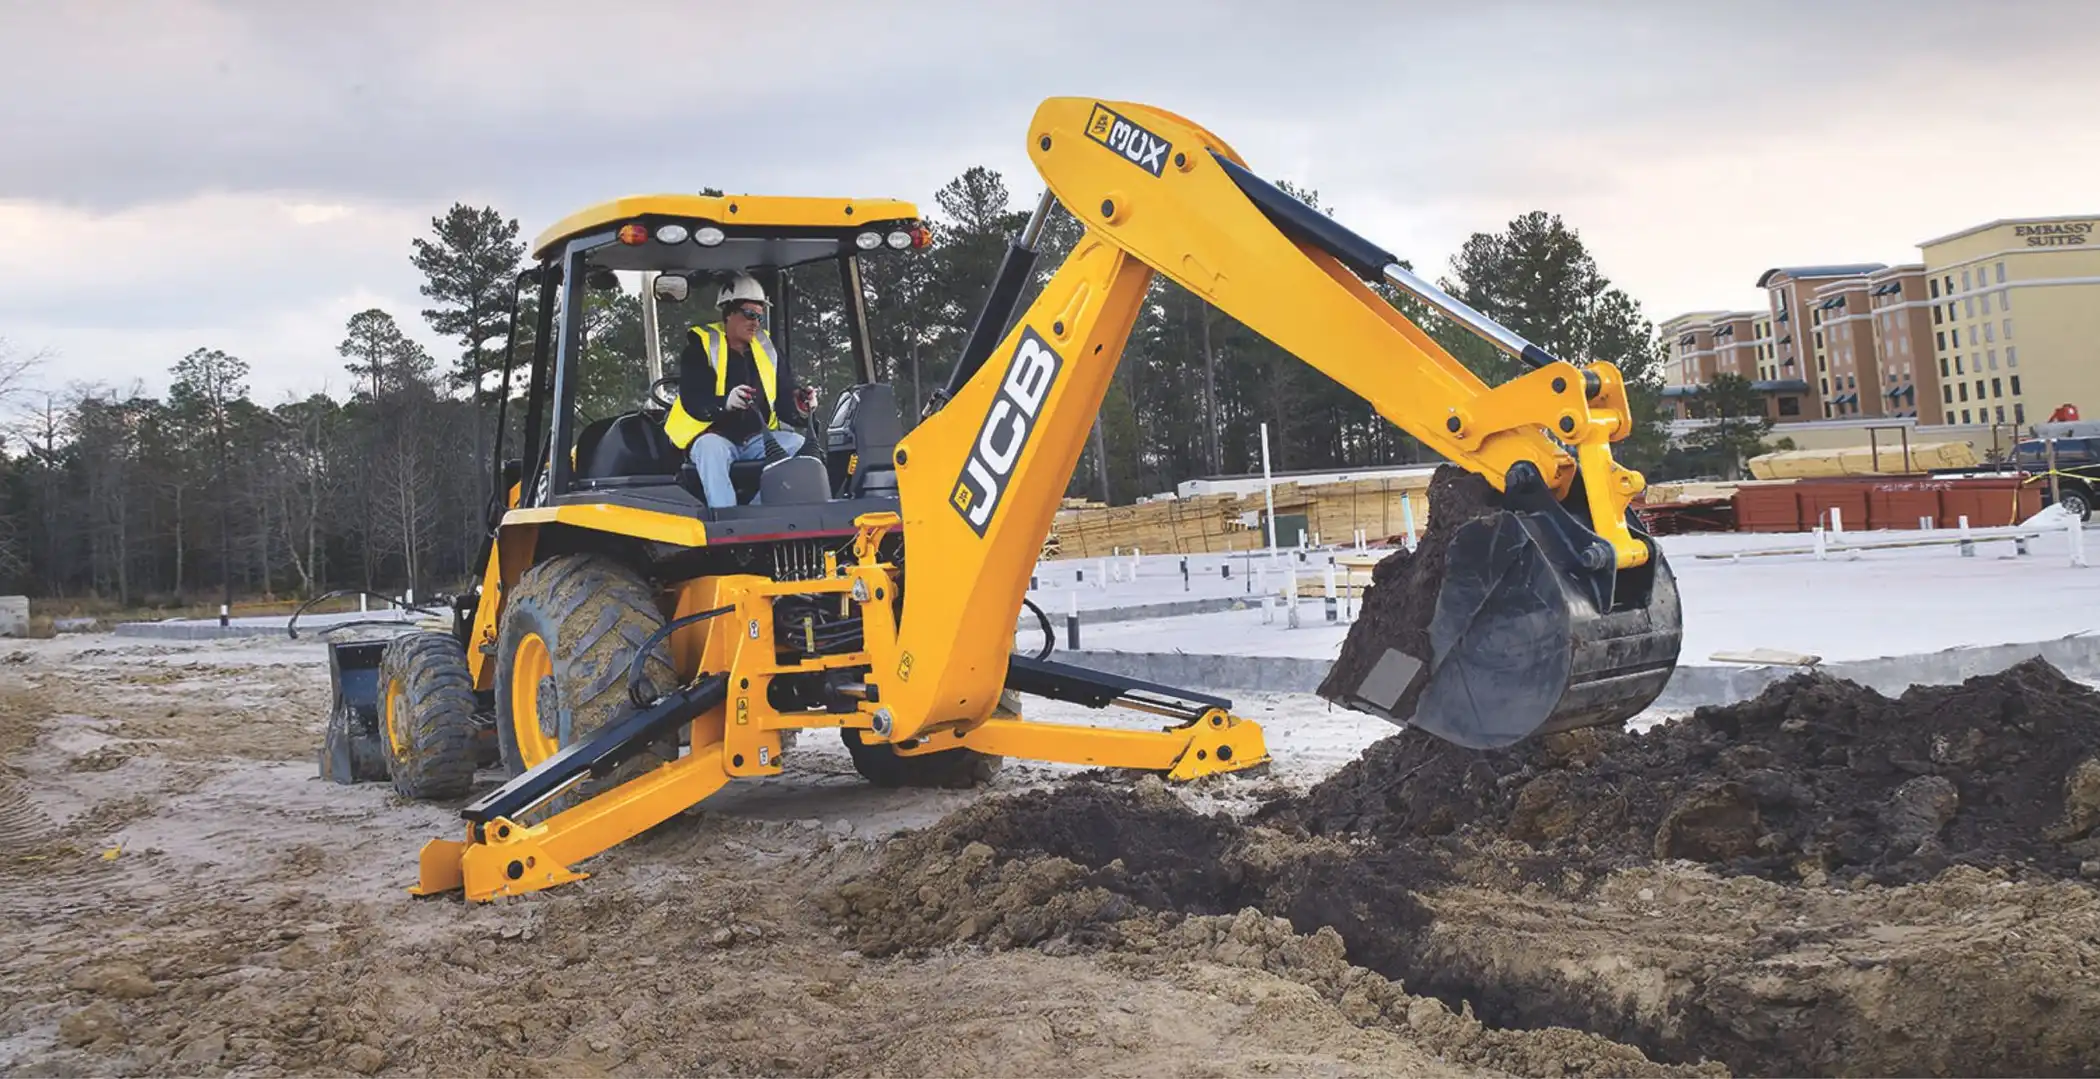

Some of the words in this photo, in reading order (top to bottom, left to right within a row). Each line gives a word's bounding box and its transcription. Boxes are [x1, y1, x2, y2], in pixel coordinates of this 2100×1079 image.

[1109, 120, 1168, 174] 3CX
[2014, 223, 2094, 236] EMBASSY
[2027, 234, 2085, 247] SUITES
[967, 338, 1055, 526] JCB
